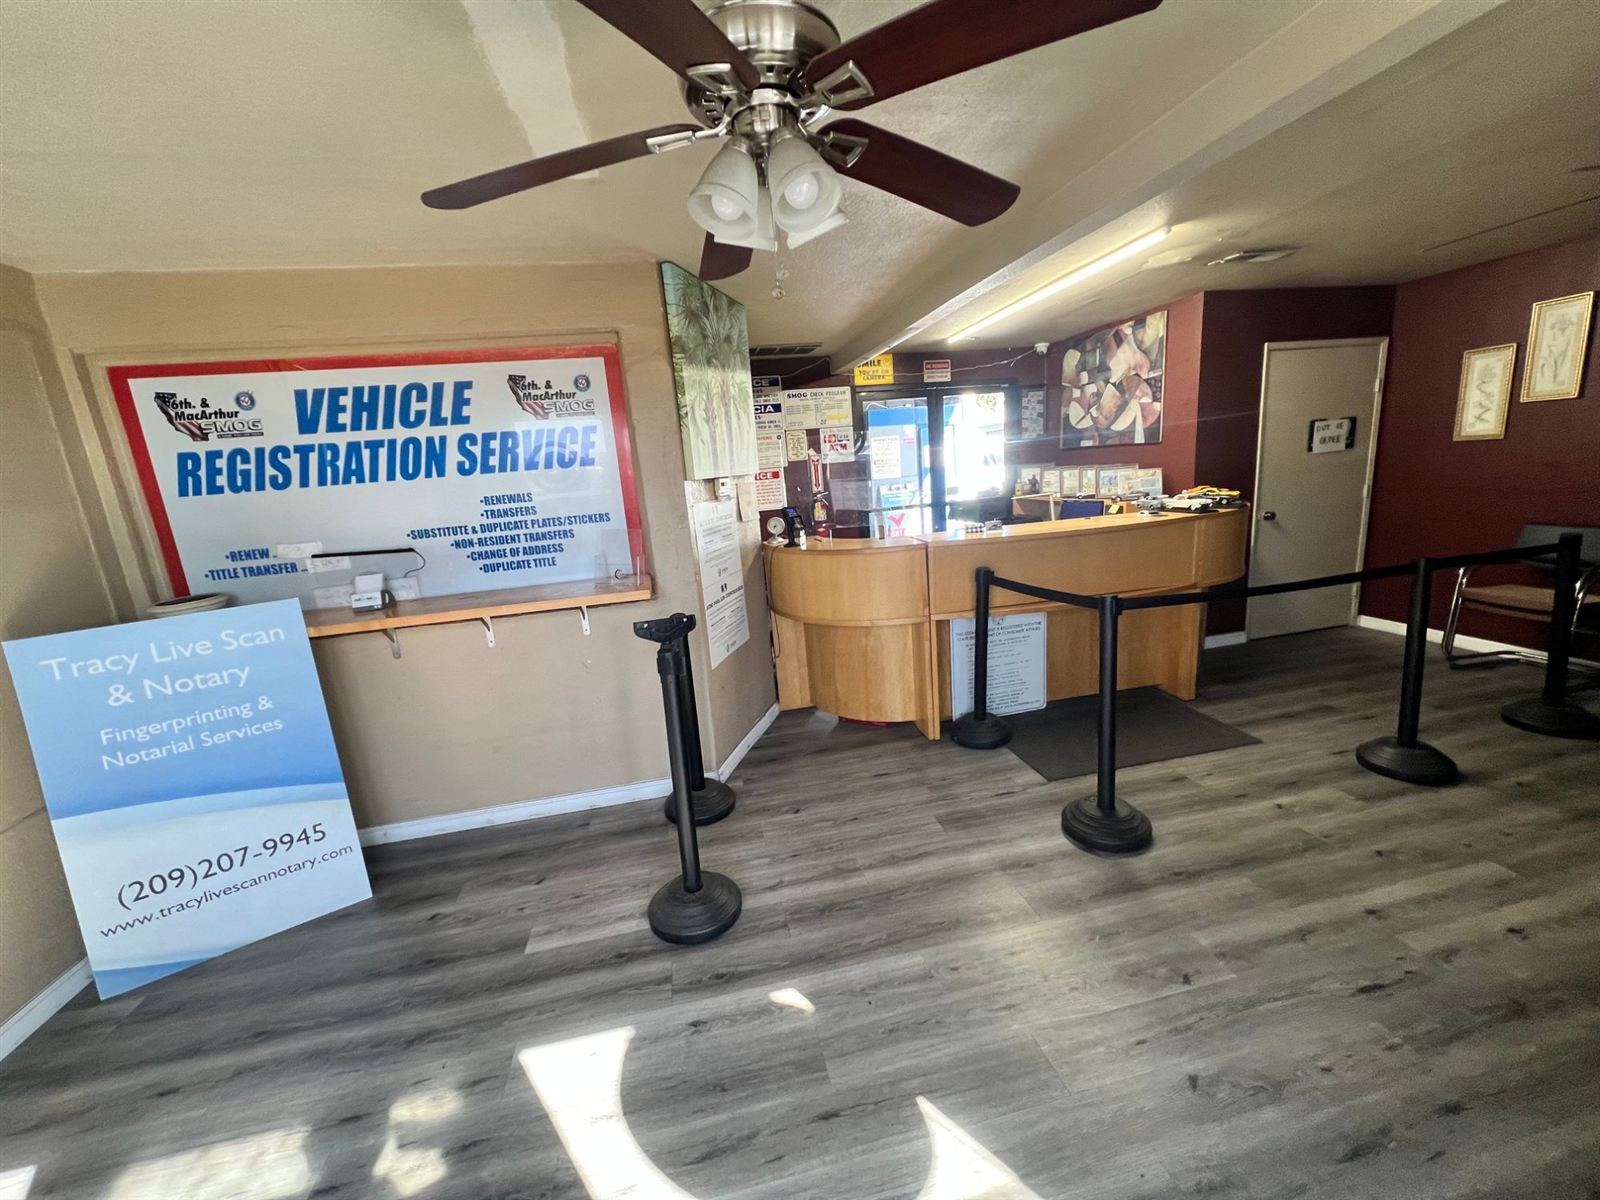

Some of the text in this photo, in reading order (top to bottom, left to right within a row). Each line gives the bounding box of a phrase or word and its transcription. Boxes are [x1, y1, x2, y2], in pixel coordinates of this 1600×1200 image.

[857, 359, 881, 368] MILE
[545, 379, 552, 389] &
[171, 398, 210, 410] 6th. &
[522, 390, 576, 402] MacArthur
[174, 408, 239, 421] MacArthur
[294, 380, 473, 436] VEHICLE
[544, 399, 595, 413] SMOG
[754, 404, 775, 413] CIA
[202, 419, 262, 433] SMOG
[177, 425, 598, 498] REGISTRATION SERVICE
[483, 492, 533, 507] RENEWALS
[484, 506, 537, 520] TRANSFERS
[410, 513, 611, 540] SUBSTITUTE & DUPLICATE PLATES/STICKERS
[454, 529, 575, 549] NON-RESIDENT TRANSFERS
[229, 548, 270, 562] RENEW
[470, 543, 564, 561] CHANGE OF ADDRESS
[208, 566, 240, 580] TITLE
[241, 562, 298, 577] TRANSFER
[483, 556, 556, 573] DUPLICATE TITLE
[39, 627, 286, 681] Tracy Live Scan
[108, 665, 252, 707] & Notary
[100, 695, 274, 745] Fingerprinting &
[101, 718, 284, 771] Notarial Services
[117, 822, 326, 911] (209)207-9945
[100, 844, 353, 938] www.tracylivescannotary.com
